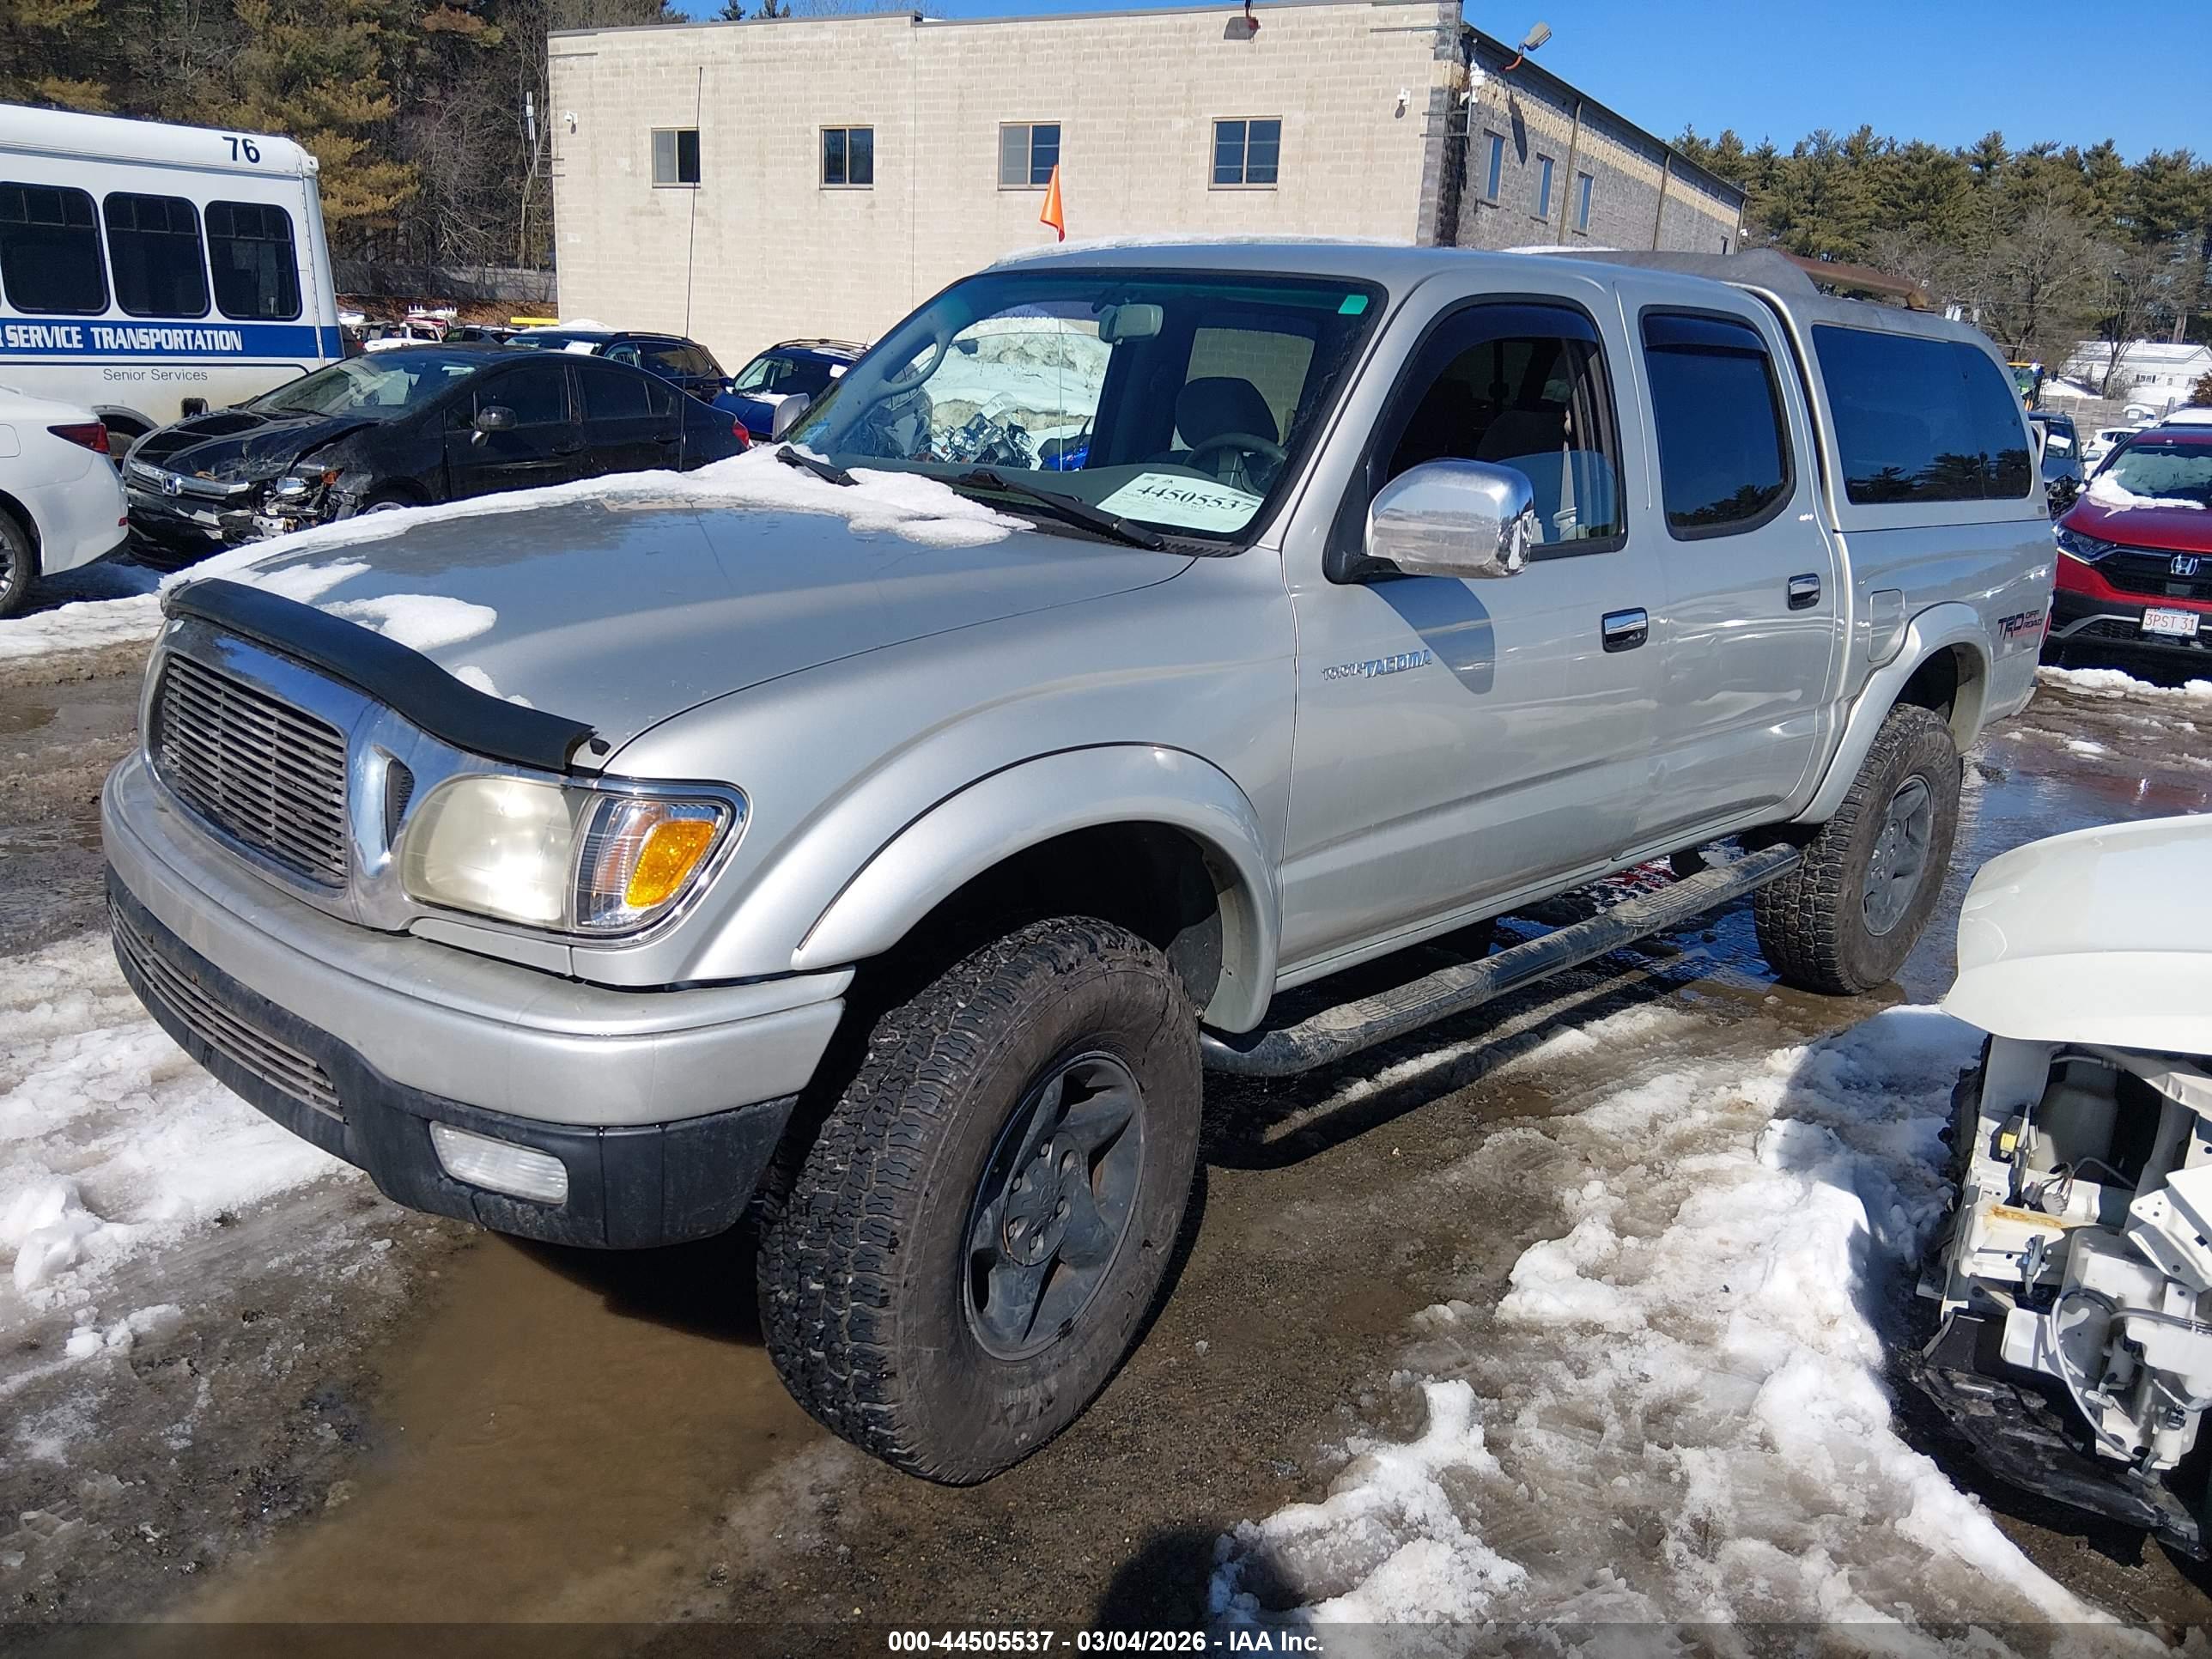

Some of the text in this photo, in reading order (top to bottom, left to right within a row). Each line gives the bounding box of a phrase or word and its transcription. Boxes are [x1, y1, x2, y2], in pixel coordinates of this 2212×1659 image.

[222, 136, 260, 163] 76
[5, 325, 84, 349] SERVICE
[90, 327, 243, 351] TRANSPORTATION
[103, 368, 208, 380] Senior Services
[1137, 485, 1257, 513] 44505537
[1997, 610, 2040, 640] TRD OFF
[2023, 618, 2043, 629] ROAD
[2145, 613, 2195, 631] 3PST 31
[1321, 649, 1432, 680] TOYOTA TACOMA
